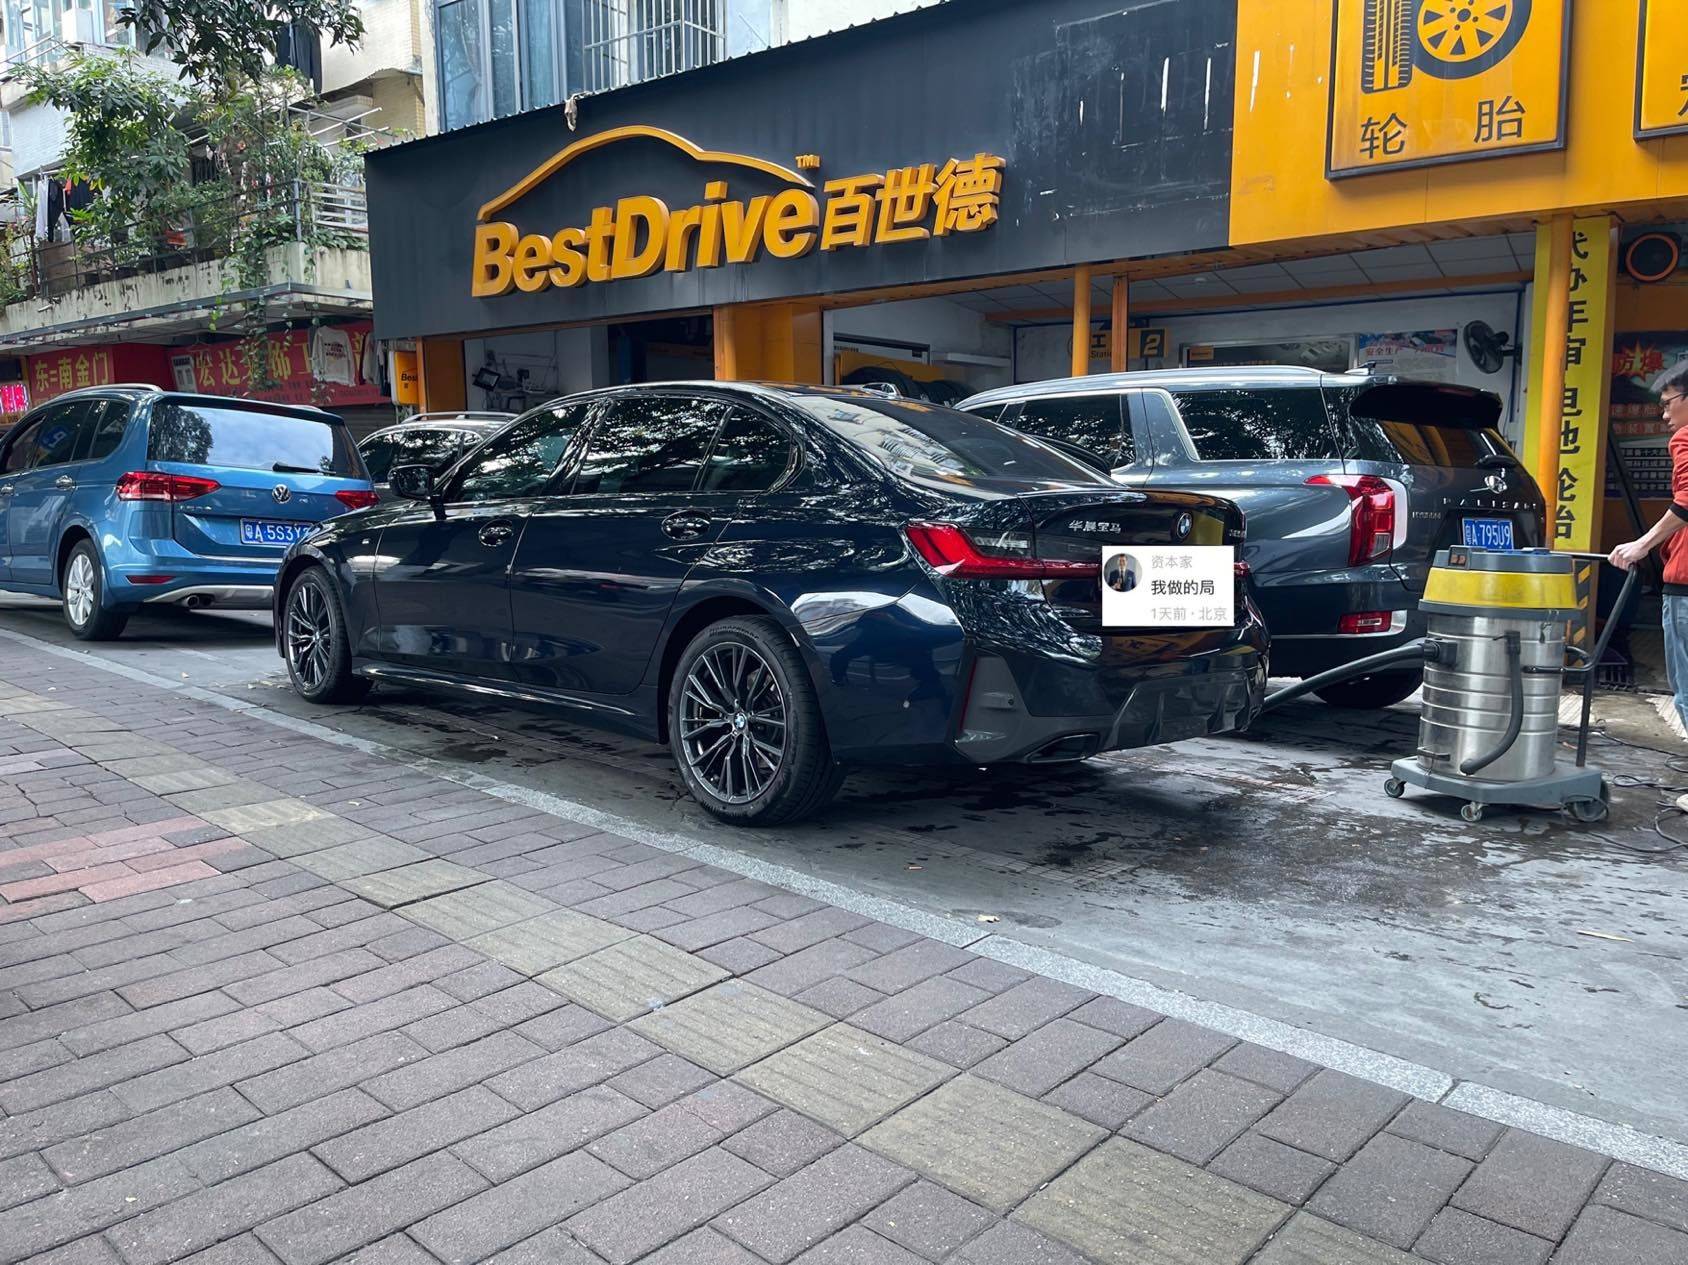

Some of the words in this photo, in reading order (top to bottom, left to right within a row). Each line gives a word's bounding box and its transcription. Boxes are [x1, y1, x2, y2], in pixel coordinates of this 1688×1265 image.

[795, 154, 821, 169] TM
[471, 180, 819, 297] BestDrive
[820, 152, 1006, 251] 百世德
[1143, 333, 1161, 356] 2
[1068, 520, 1121, 534] 华晨宝马
